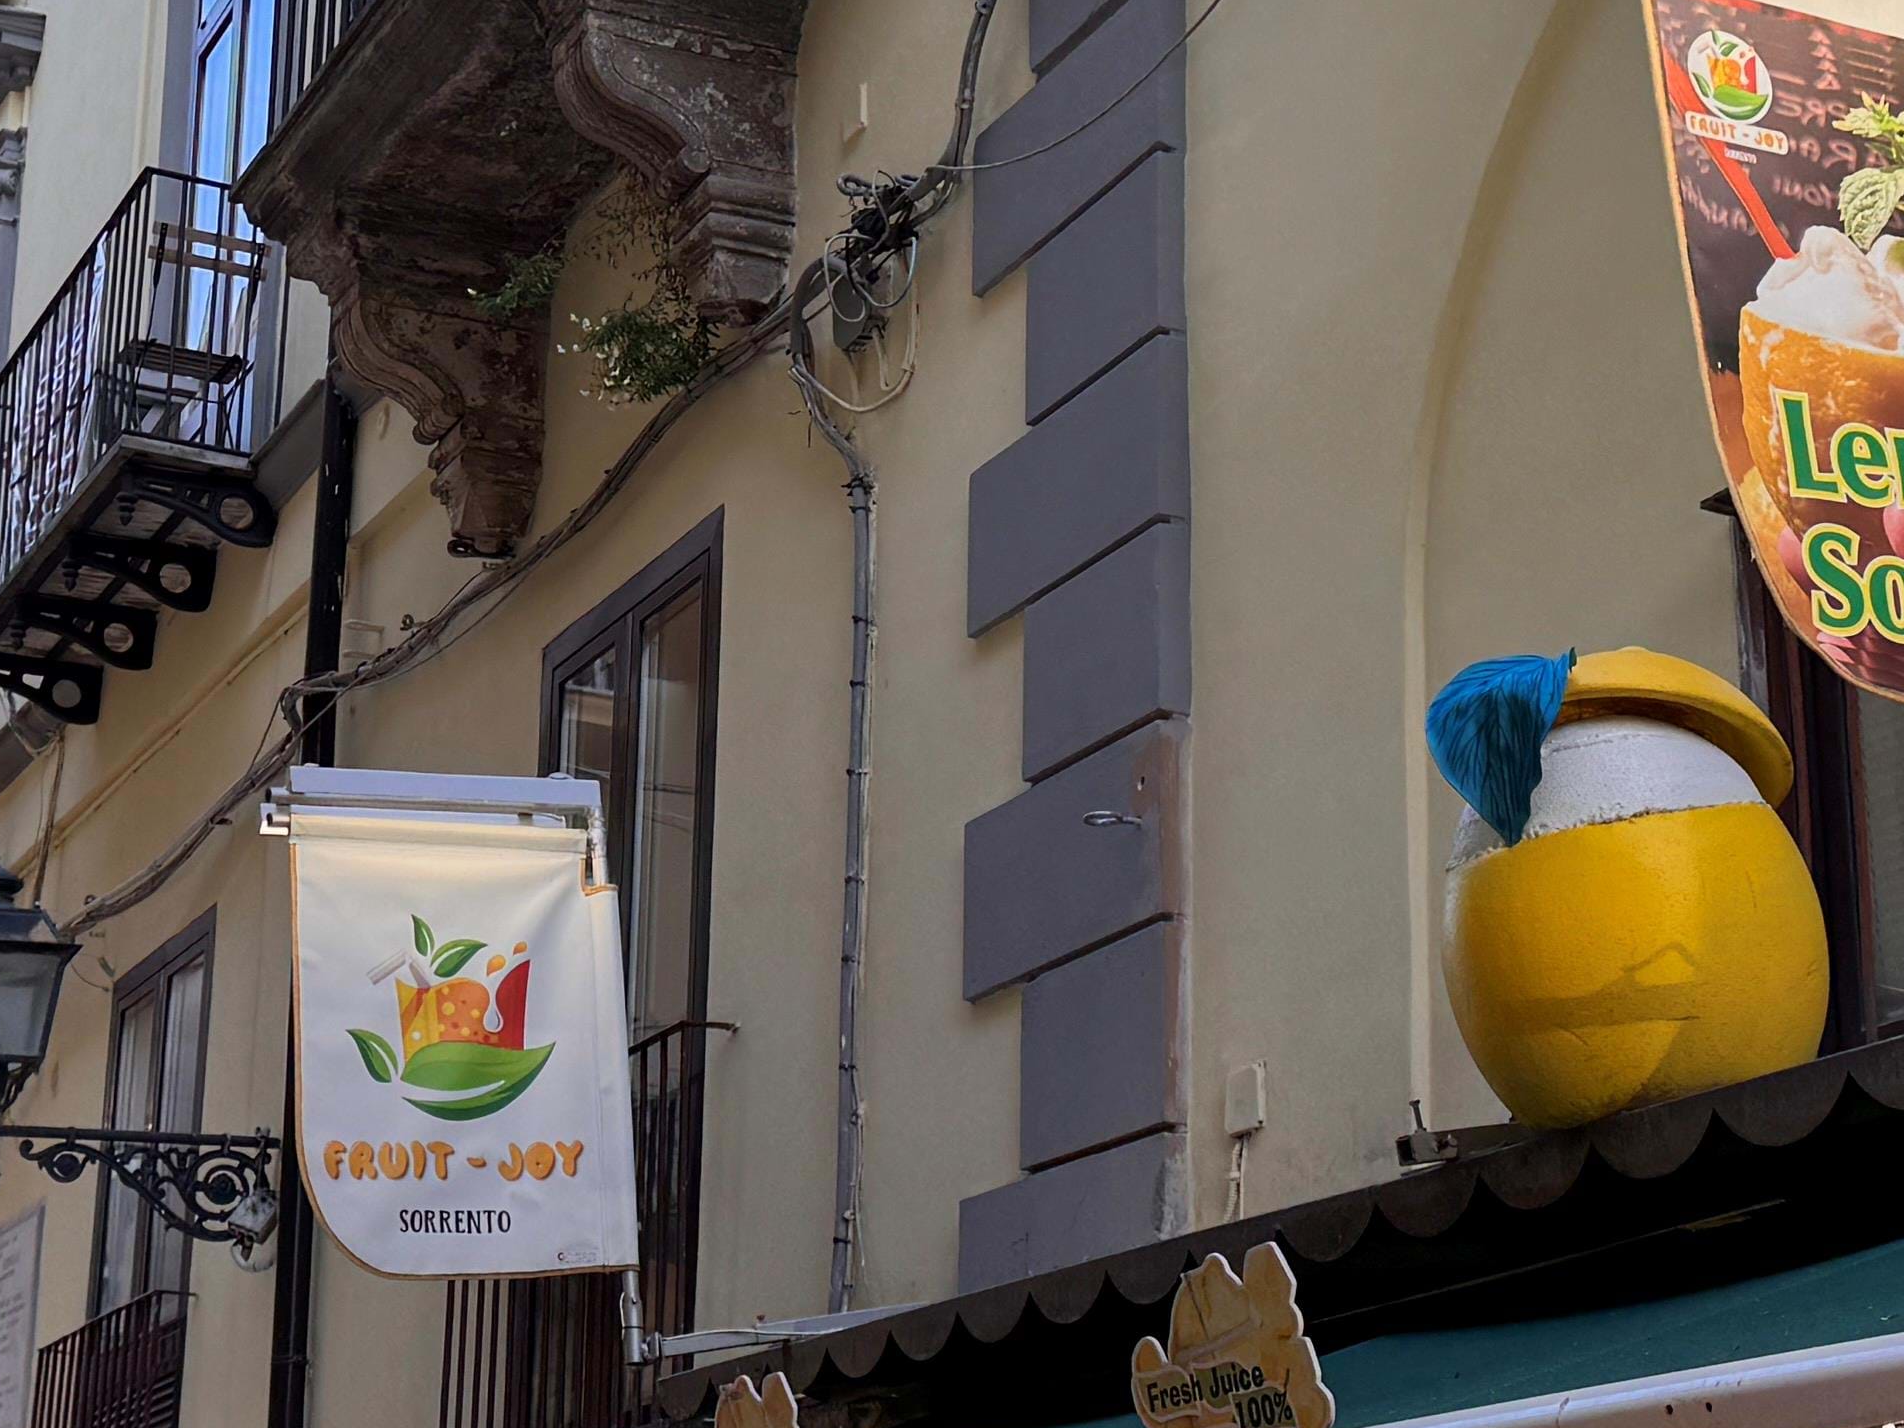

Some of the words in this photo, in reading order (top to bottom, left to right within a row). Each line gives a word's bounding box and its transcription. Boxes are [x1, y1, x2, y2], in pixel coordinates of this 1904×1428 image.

[1689, 114, 1737, 141] FRUIT
[1754, 129, 1786, 151] JOY
[323, 1139, 456, 1181] FRUIT
[497, 1138, 586, 1181] JOY
[398, 1208, 512, 1235] SORRENTO
[1146, 1372, 1204, 1412] Fresh
[1209, 1362, 1265, 1399] Juice
